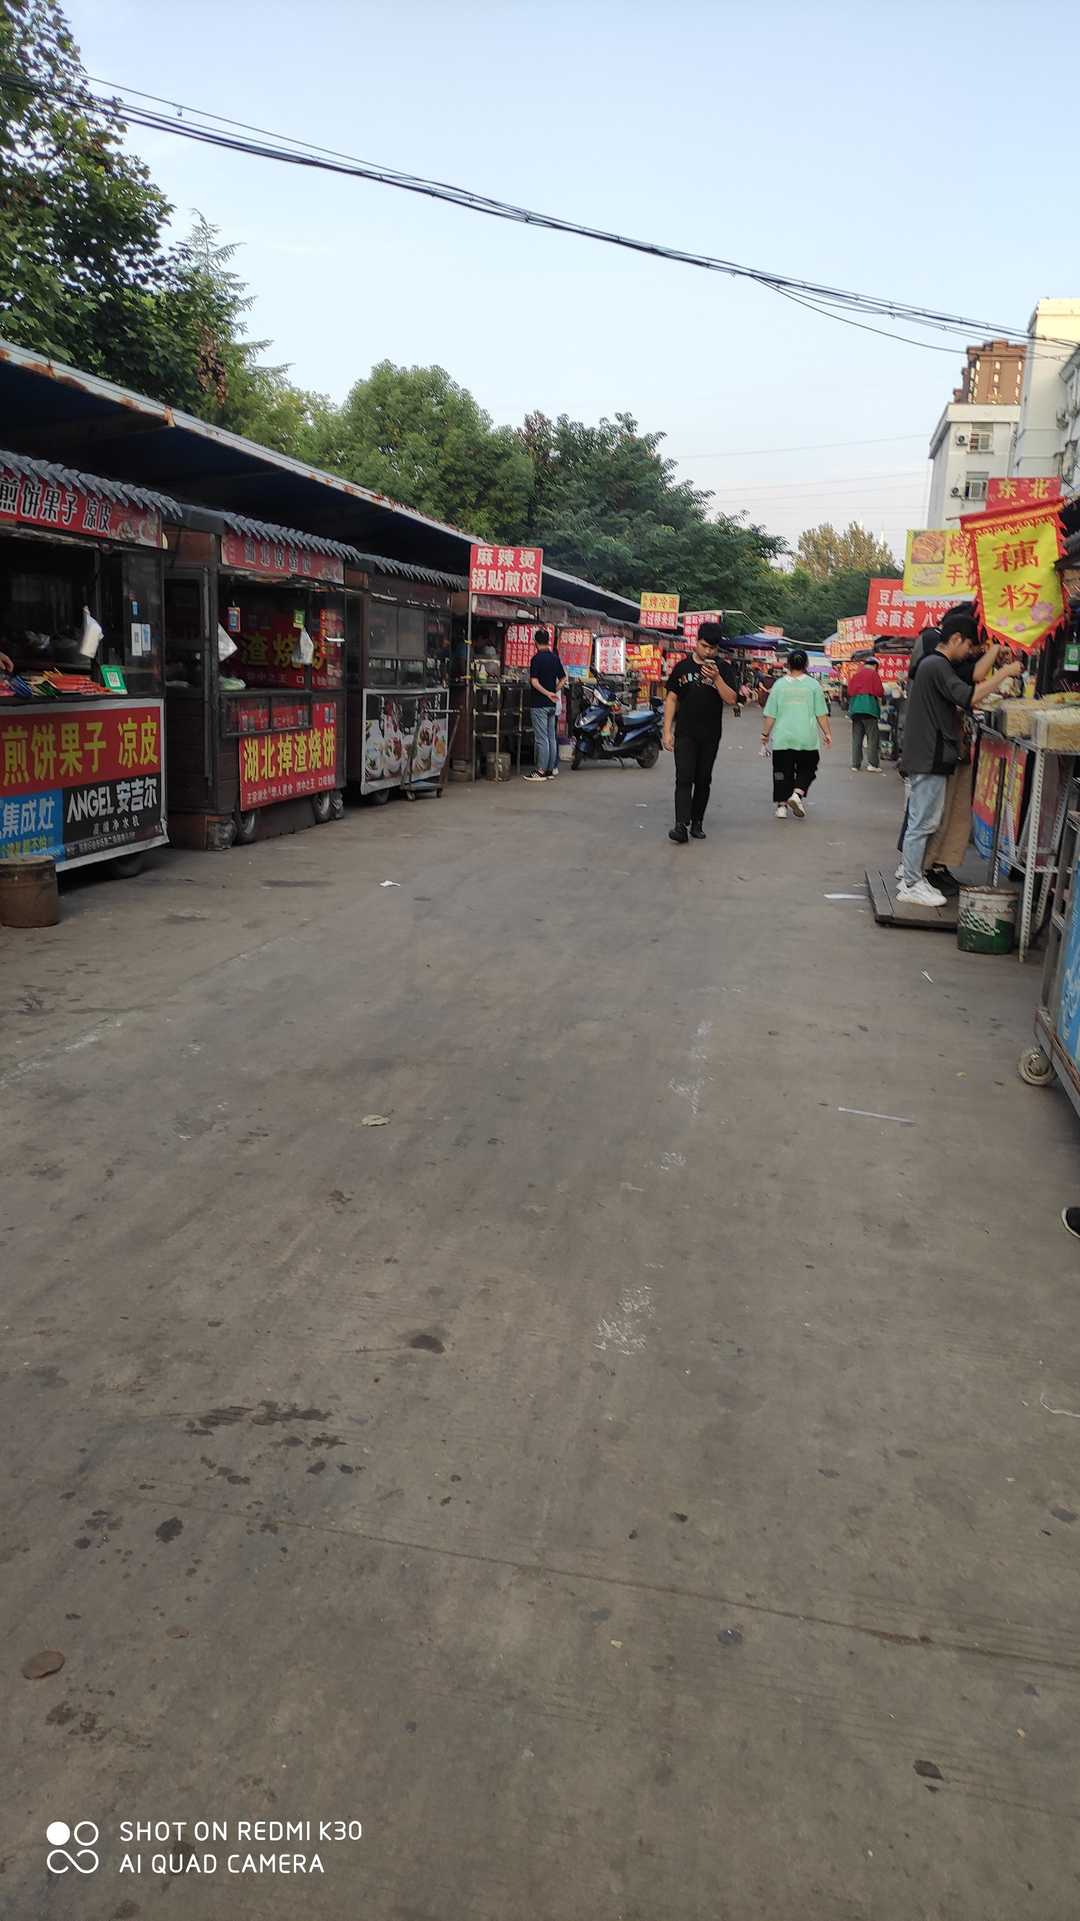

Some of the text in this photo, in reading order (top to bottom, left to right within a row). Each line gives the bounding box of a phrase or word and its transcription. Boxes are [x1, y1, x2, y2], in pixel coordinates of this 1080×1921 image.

[0, 477, 112, 534] 煎饼果子 凉皮
[998, 478, 1049, 499] 东北
[477, 549, 536, 570] 麻辣烫
[993, 539, 1041, 611] 藕粉
[471, 570, 538, 595] 锅贴煎饺
[876, 609, 915, 628] 杂面条
[3, 715, 159, 786] 煎饼果子 凉皮
[244, 727, 336, 784] 湖北掉渣烧饼
[0, 796, 55, 839] 集成灶
[67, 777, 158, 824] ANGEL 安吉尔
